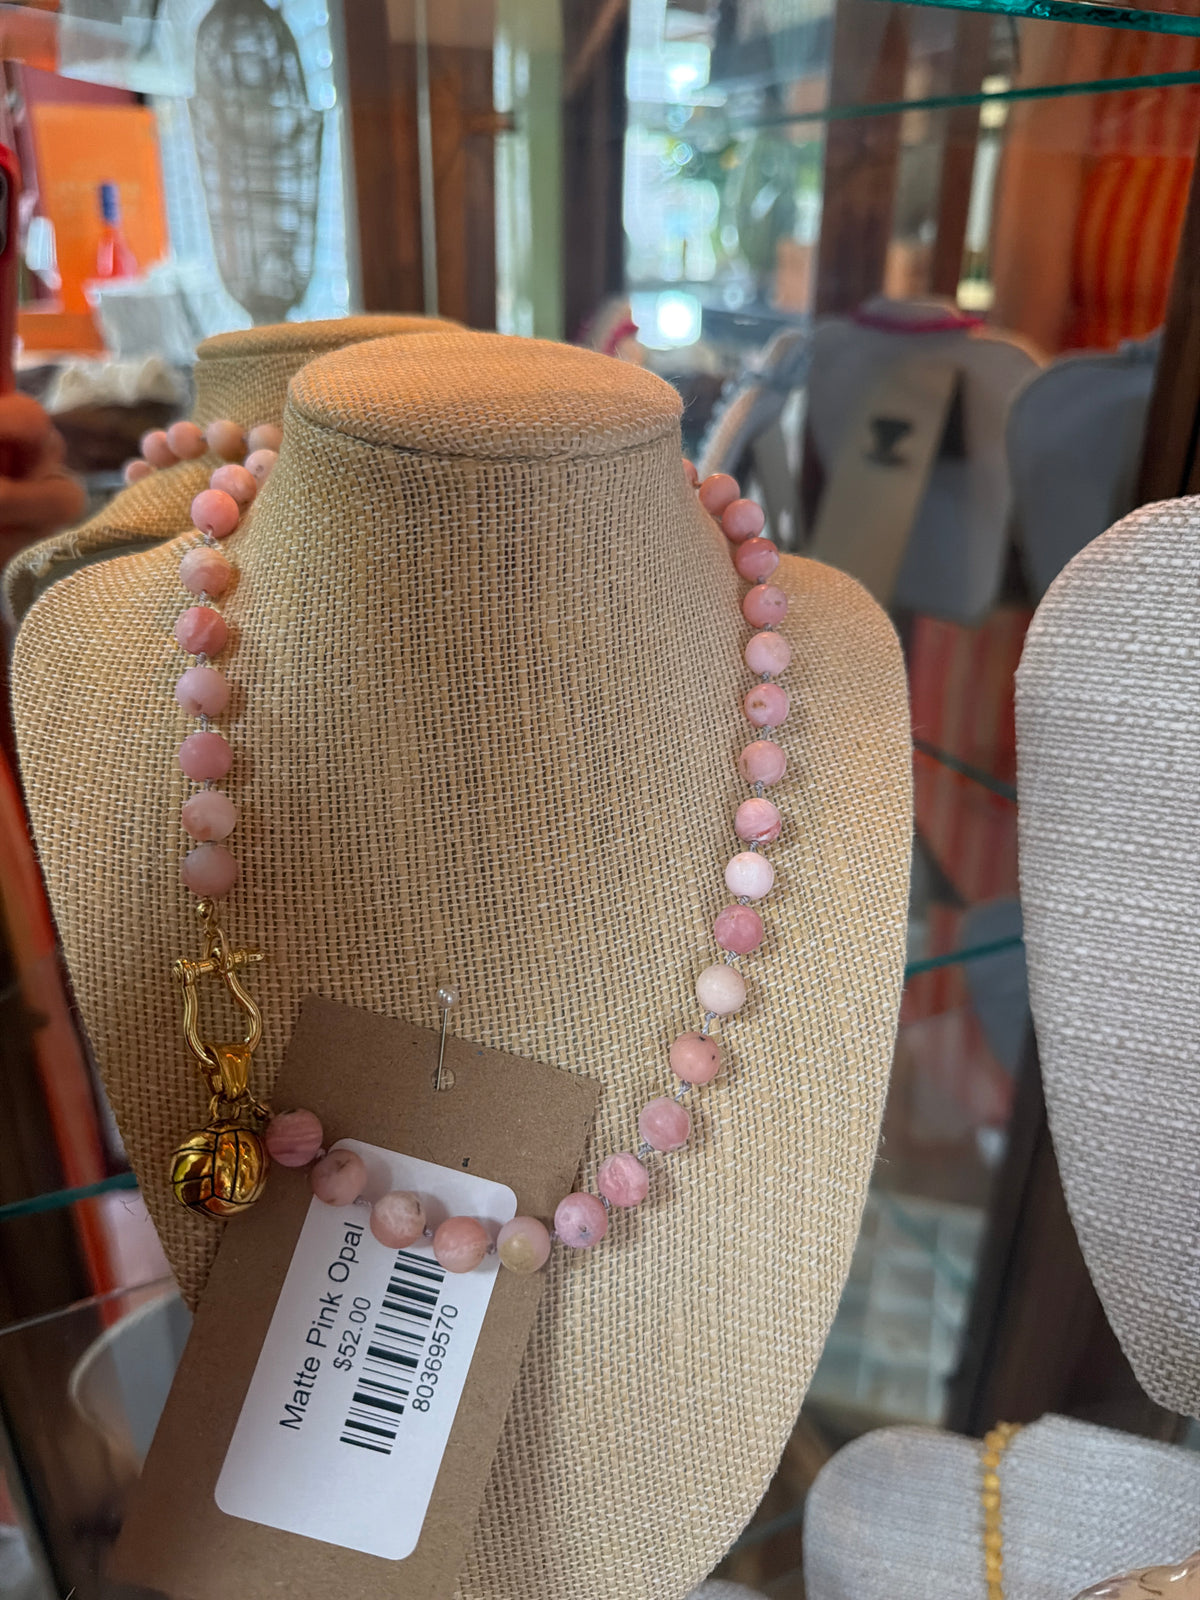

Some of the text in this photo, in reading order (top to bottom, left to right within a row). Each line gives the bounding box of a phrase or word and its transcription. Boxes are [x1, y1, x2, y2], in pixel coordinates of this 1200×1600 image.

[279, 1221, 365, 1431] Matte Pink Opal
[333, 1297, 372, 1372] $52.00
[411, 1304, 459, 1413] 80369570
